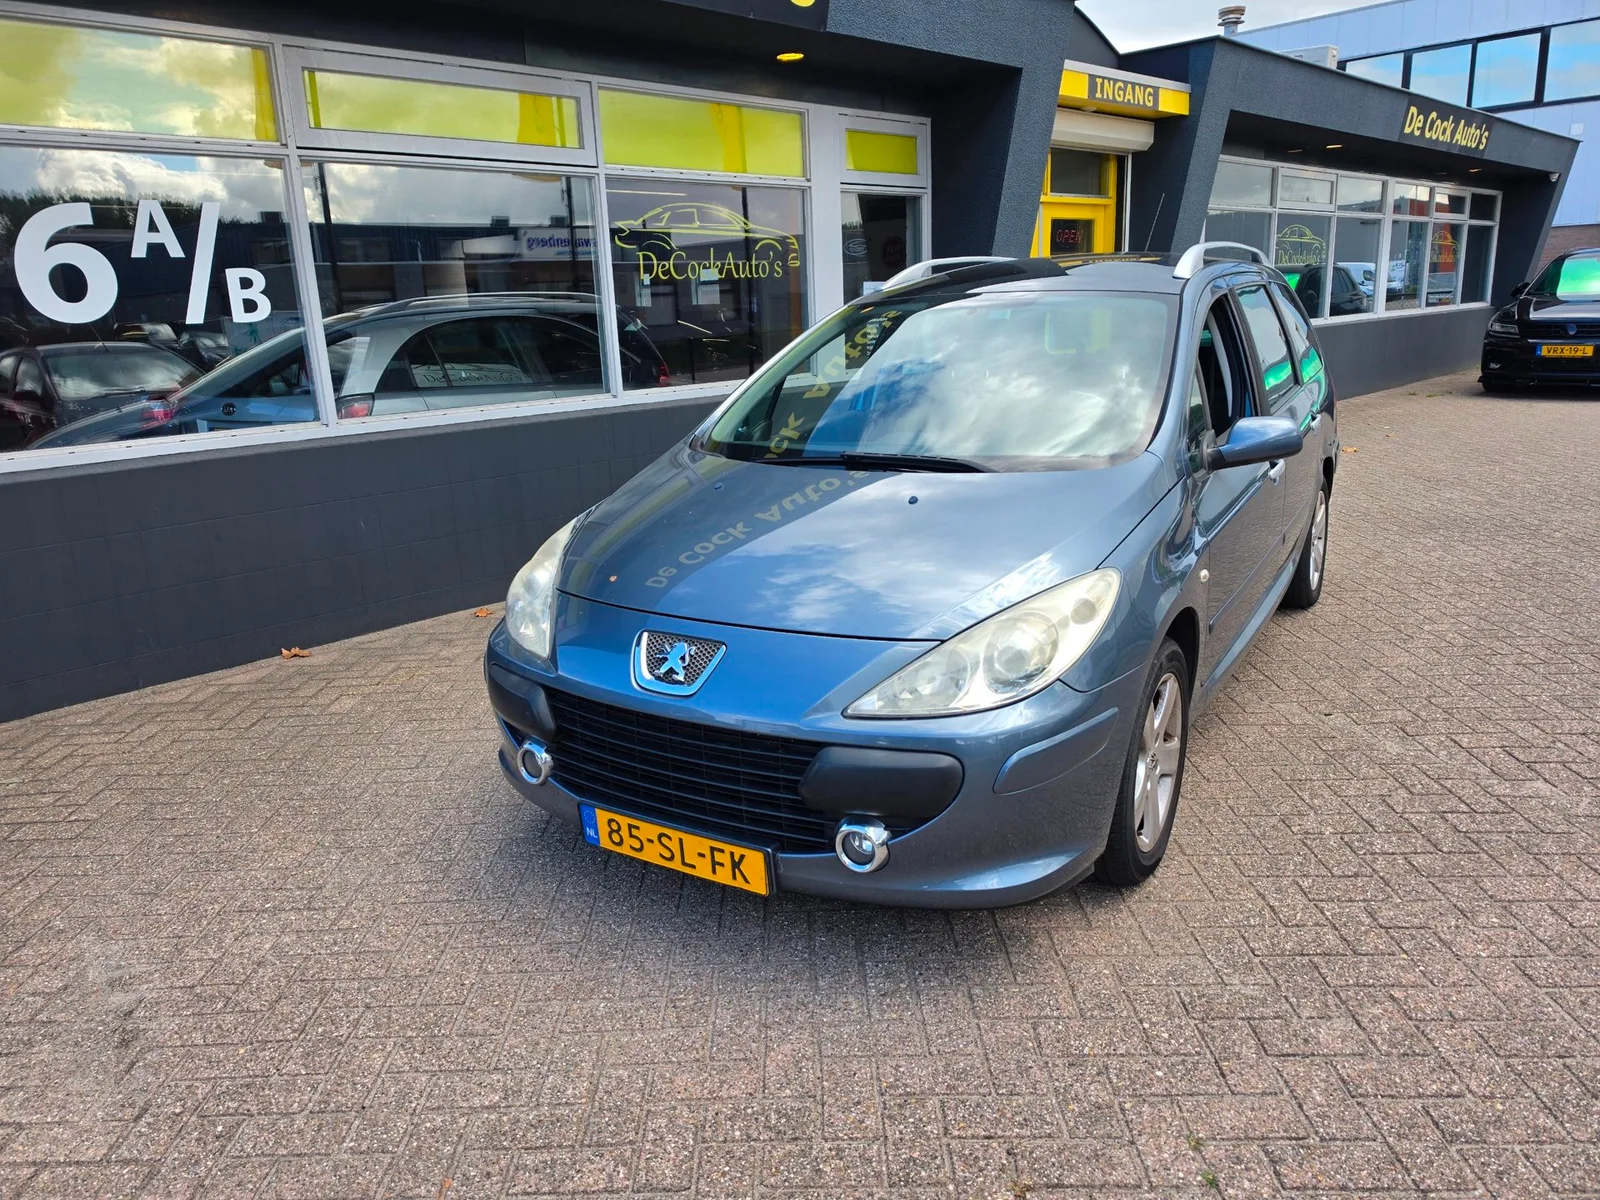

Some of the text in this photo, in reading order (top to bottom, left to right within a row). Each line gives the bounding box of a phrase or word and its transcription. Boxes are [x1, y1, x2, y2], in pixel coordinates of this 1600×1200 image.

[1095, 77, 1154, 107] INGANG
[1403, 105, 1489, 150] De Cock Auto's
[1056, 229, 1084, 243] OPEN
[635, 247, 783, 280] DeCockAuto's
[1546, 346, 1588, 355] VRX-19-L
[586, 826, 598, 839] NL
[606, 817, 751, 885] 85-SL-FK
